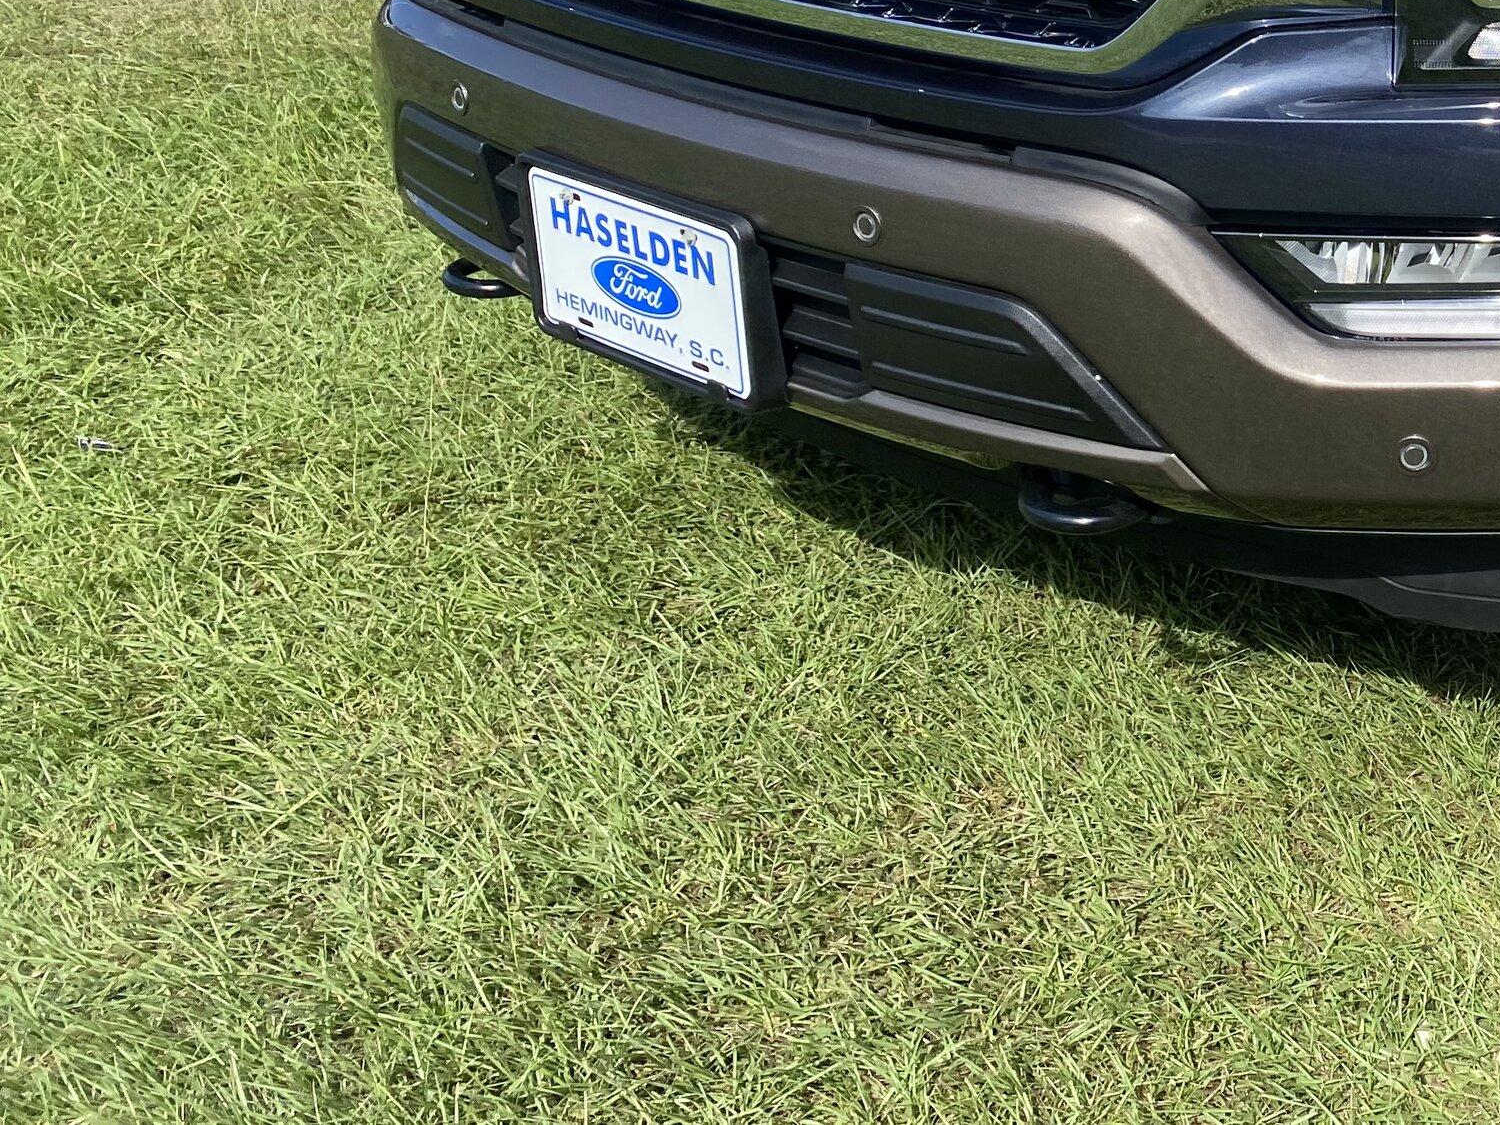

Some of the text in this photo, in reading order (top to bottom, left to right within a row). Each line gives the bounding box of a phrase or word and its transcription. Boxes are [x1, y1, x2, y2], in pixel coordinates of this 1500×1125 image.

[549, 196, 717, 286] HASELDEN
[609, 262, 664, 310] Ford
[555, 287, 731, 370] HEMINGWAY, S.C.
